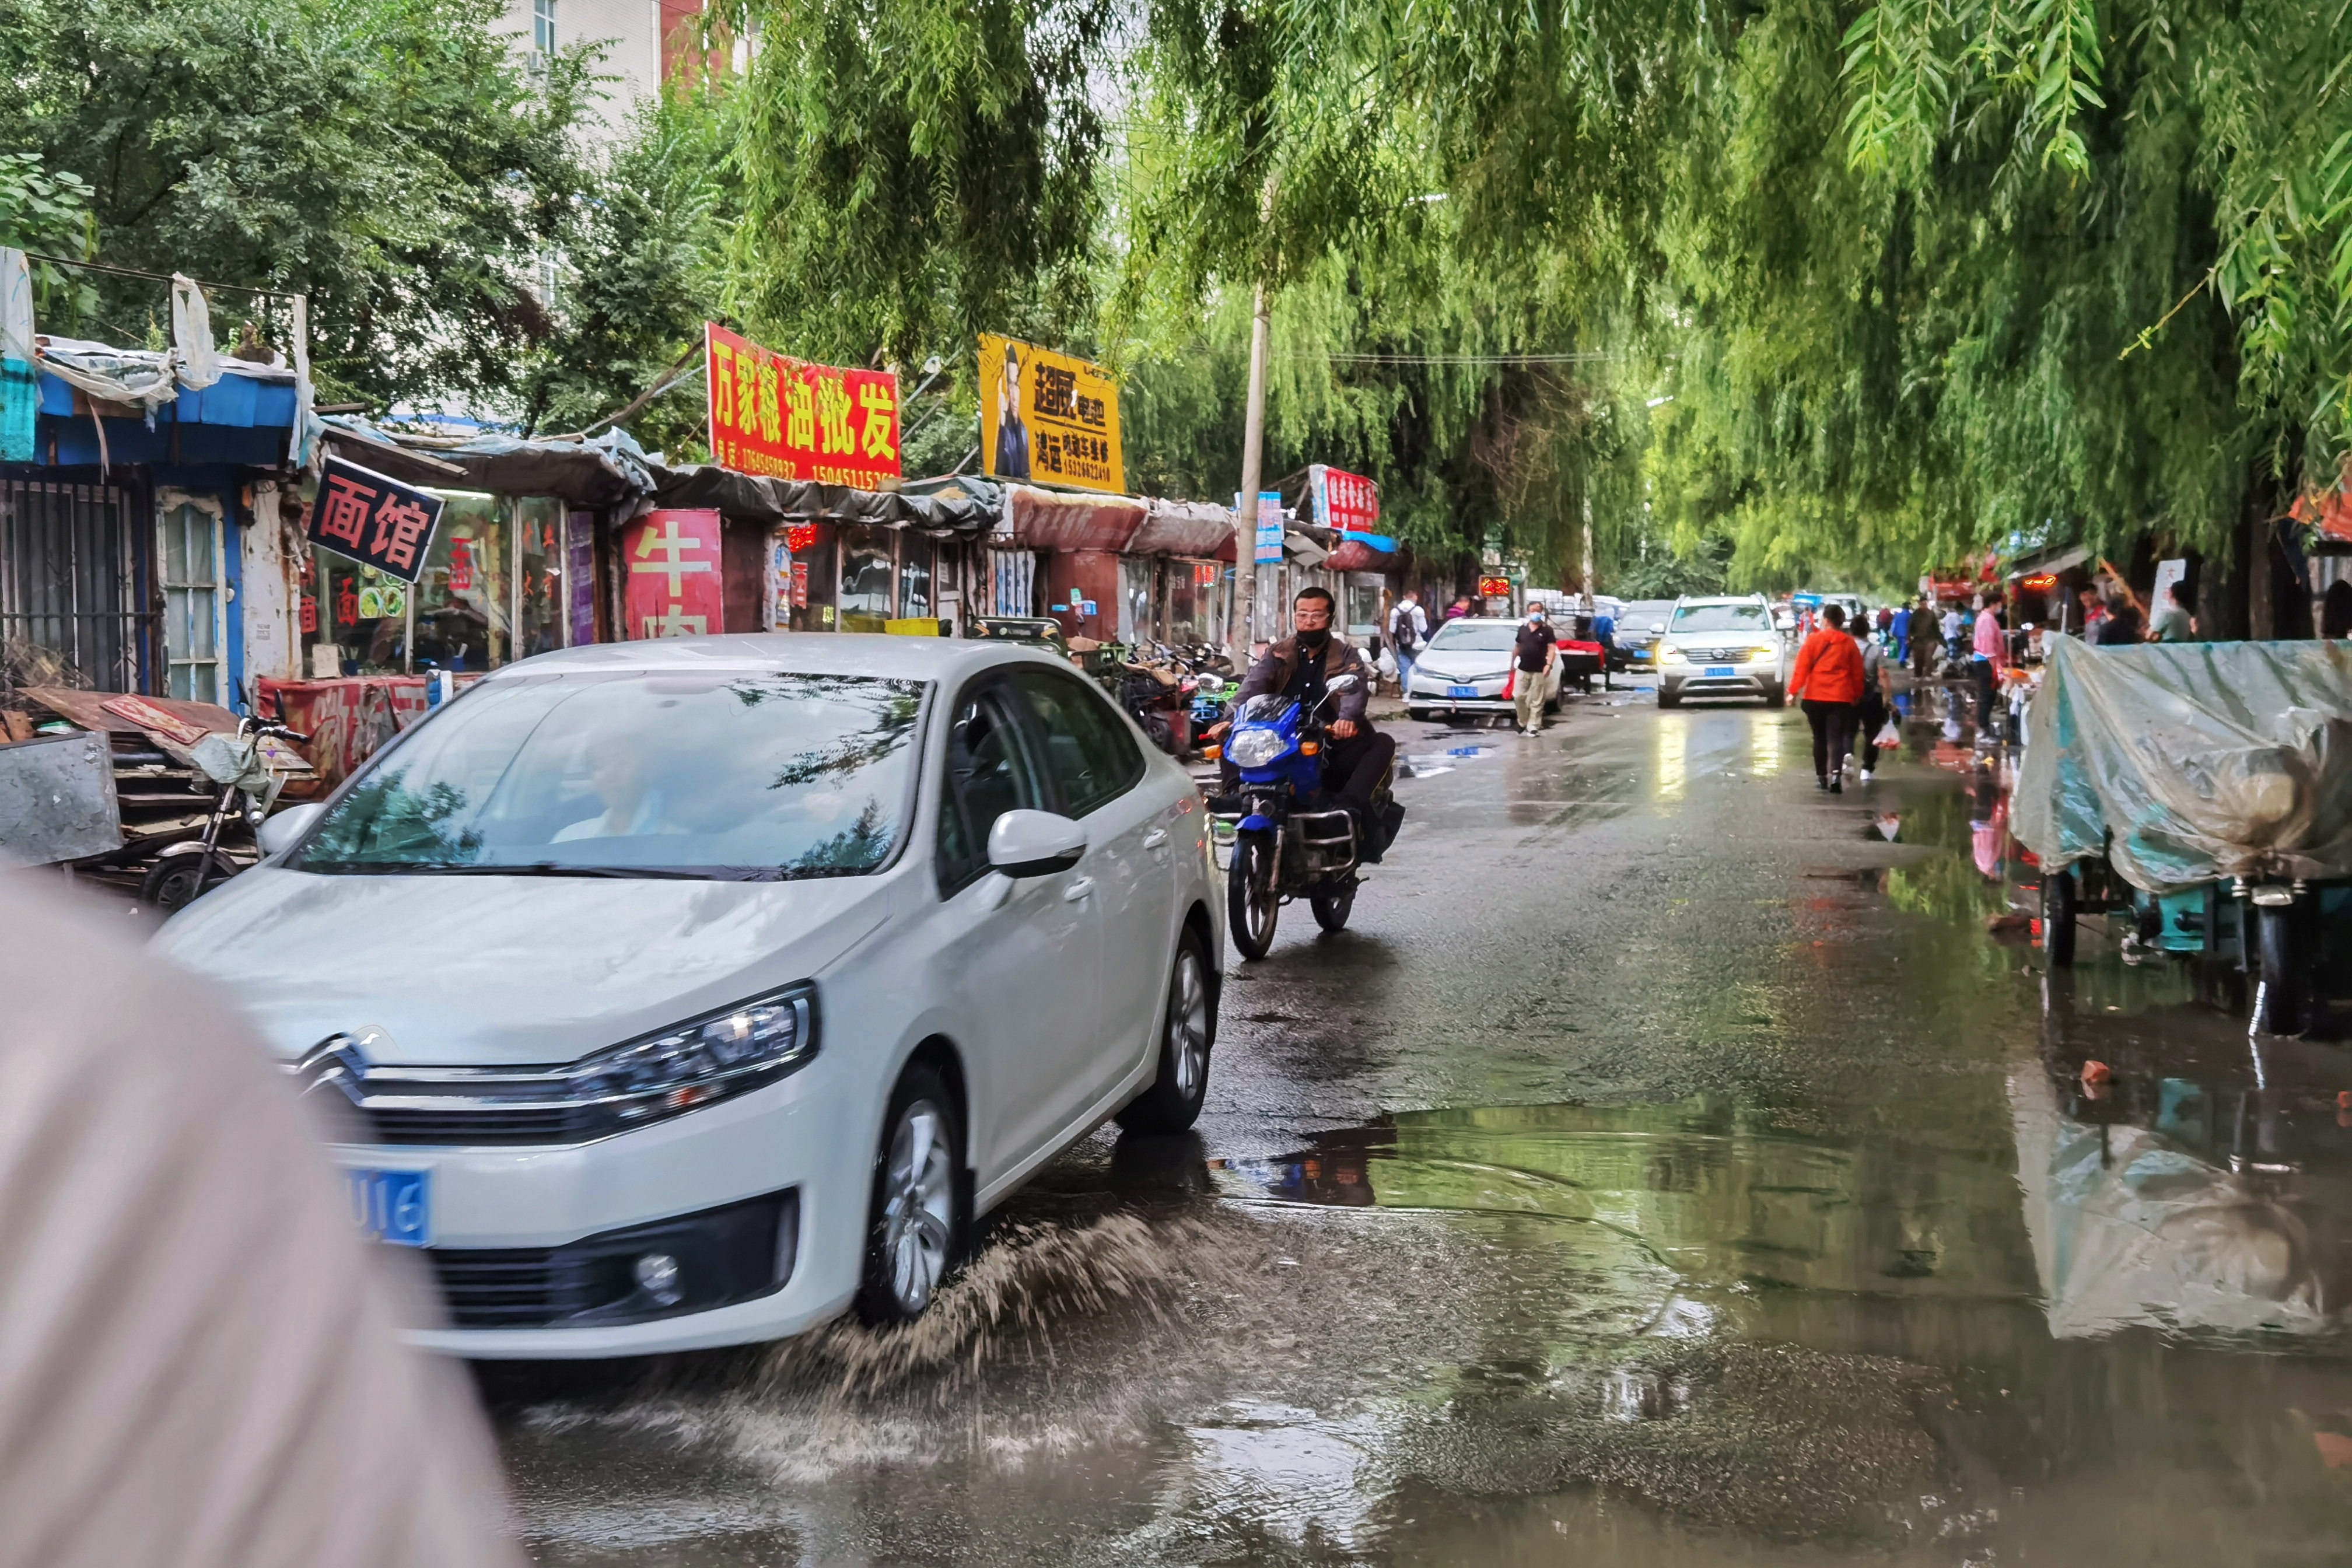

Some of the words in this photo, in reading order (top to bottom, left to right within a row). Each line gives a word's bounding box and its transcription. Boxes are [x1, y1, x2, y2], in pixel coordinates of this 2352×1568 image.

[713, 340, 895, 461] 万家粮油批发
[320, 474, 429, 570] 面馆
[813, 466, 895, 491] 15045115
